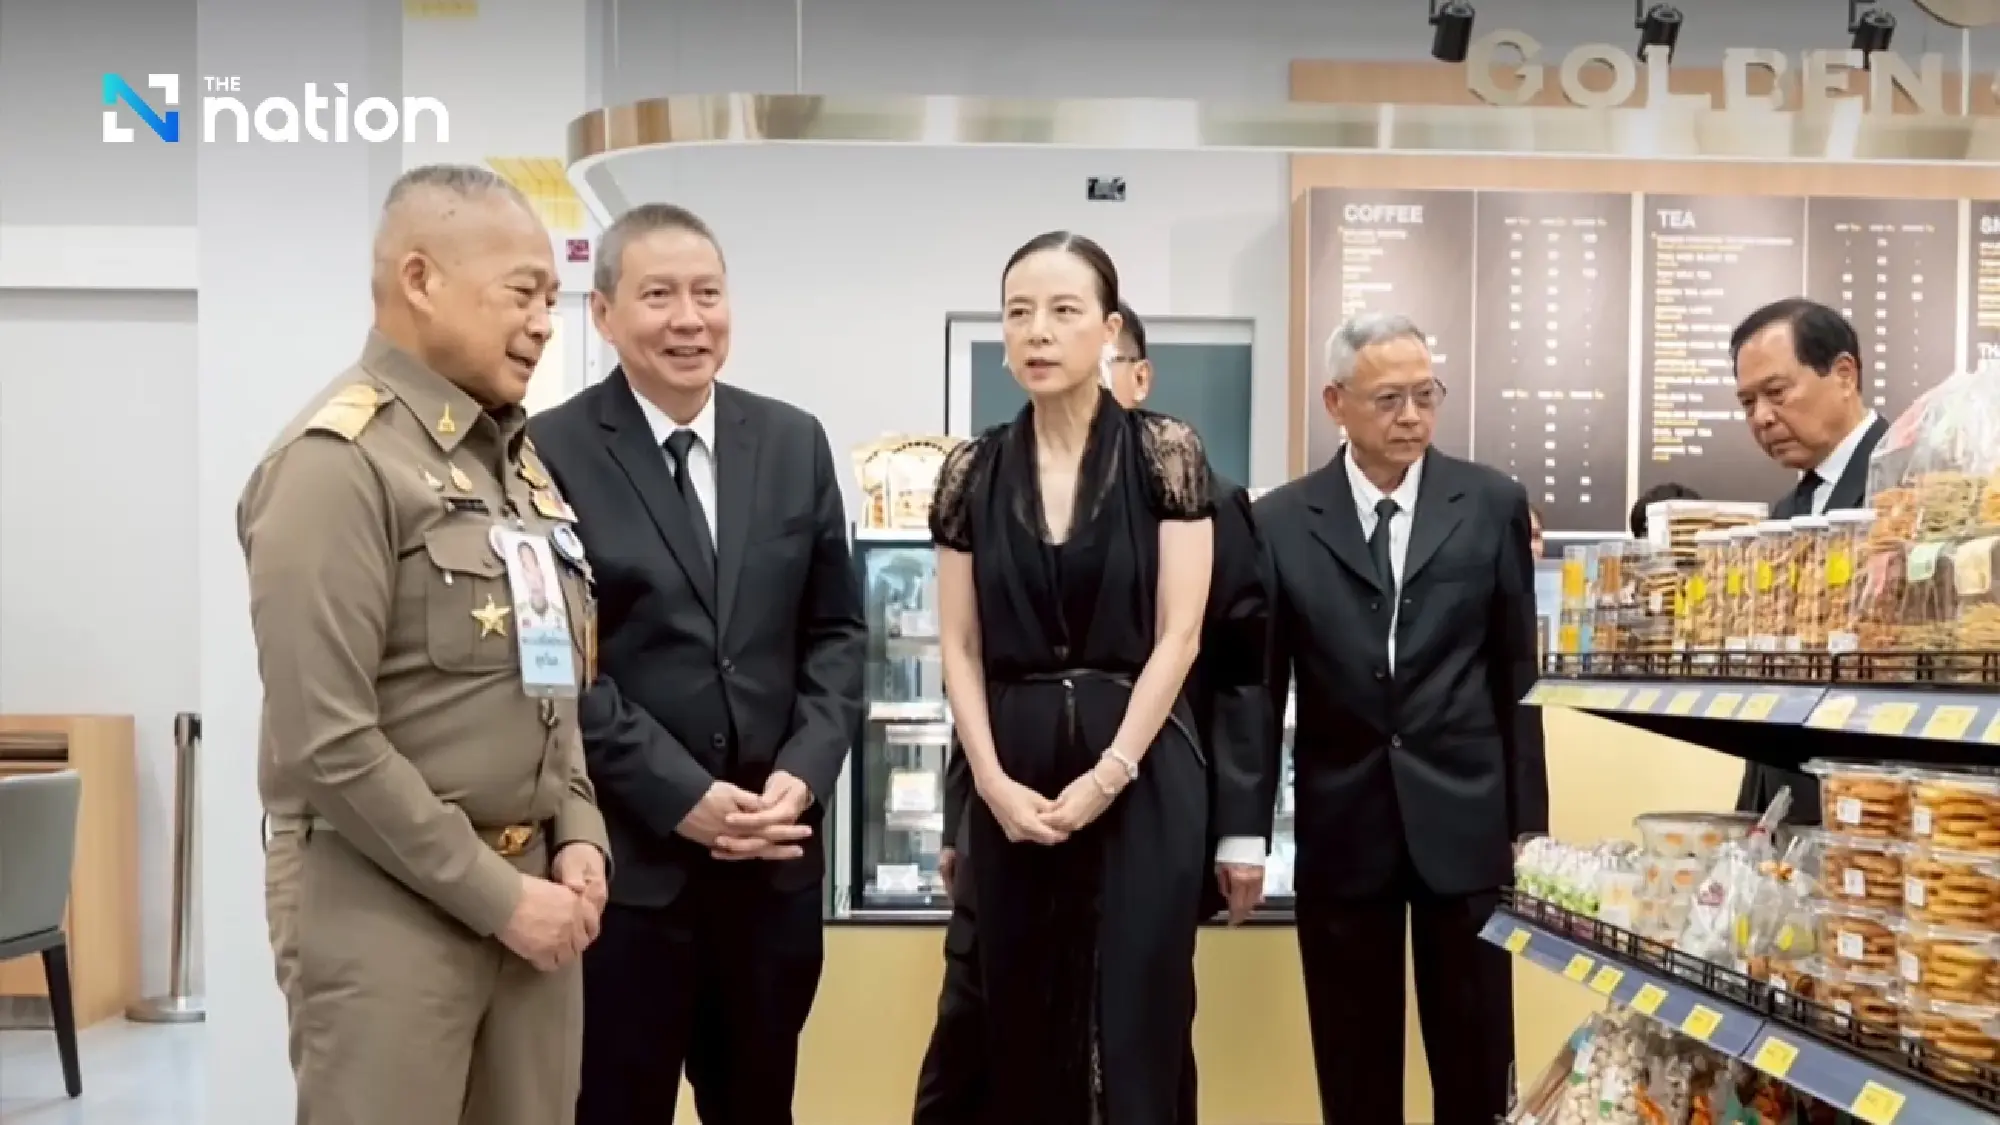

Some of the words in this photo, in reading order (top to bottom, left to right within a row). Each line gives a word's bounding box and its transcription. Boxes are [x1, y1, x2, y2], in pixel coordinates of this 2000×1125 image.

[1466, 28, 1946, 118] GOLDEN
[1344, 204, 1424, 224] COFFEE
[1656, 208, 1696, 229] TEA
